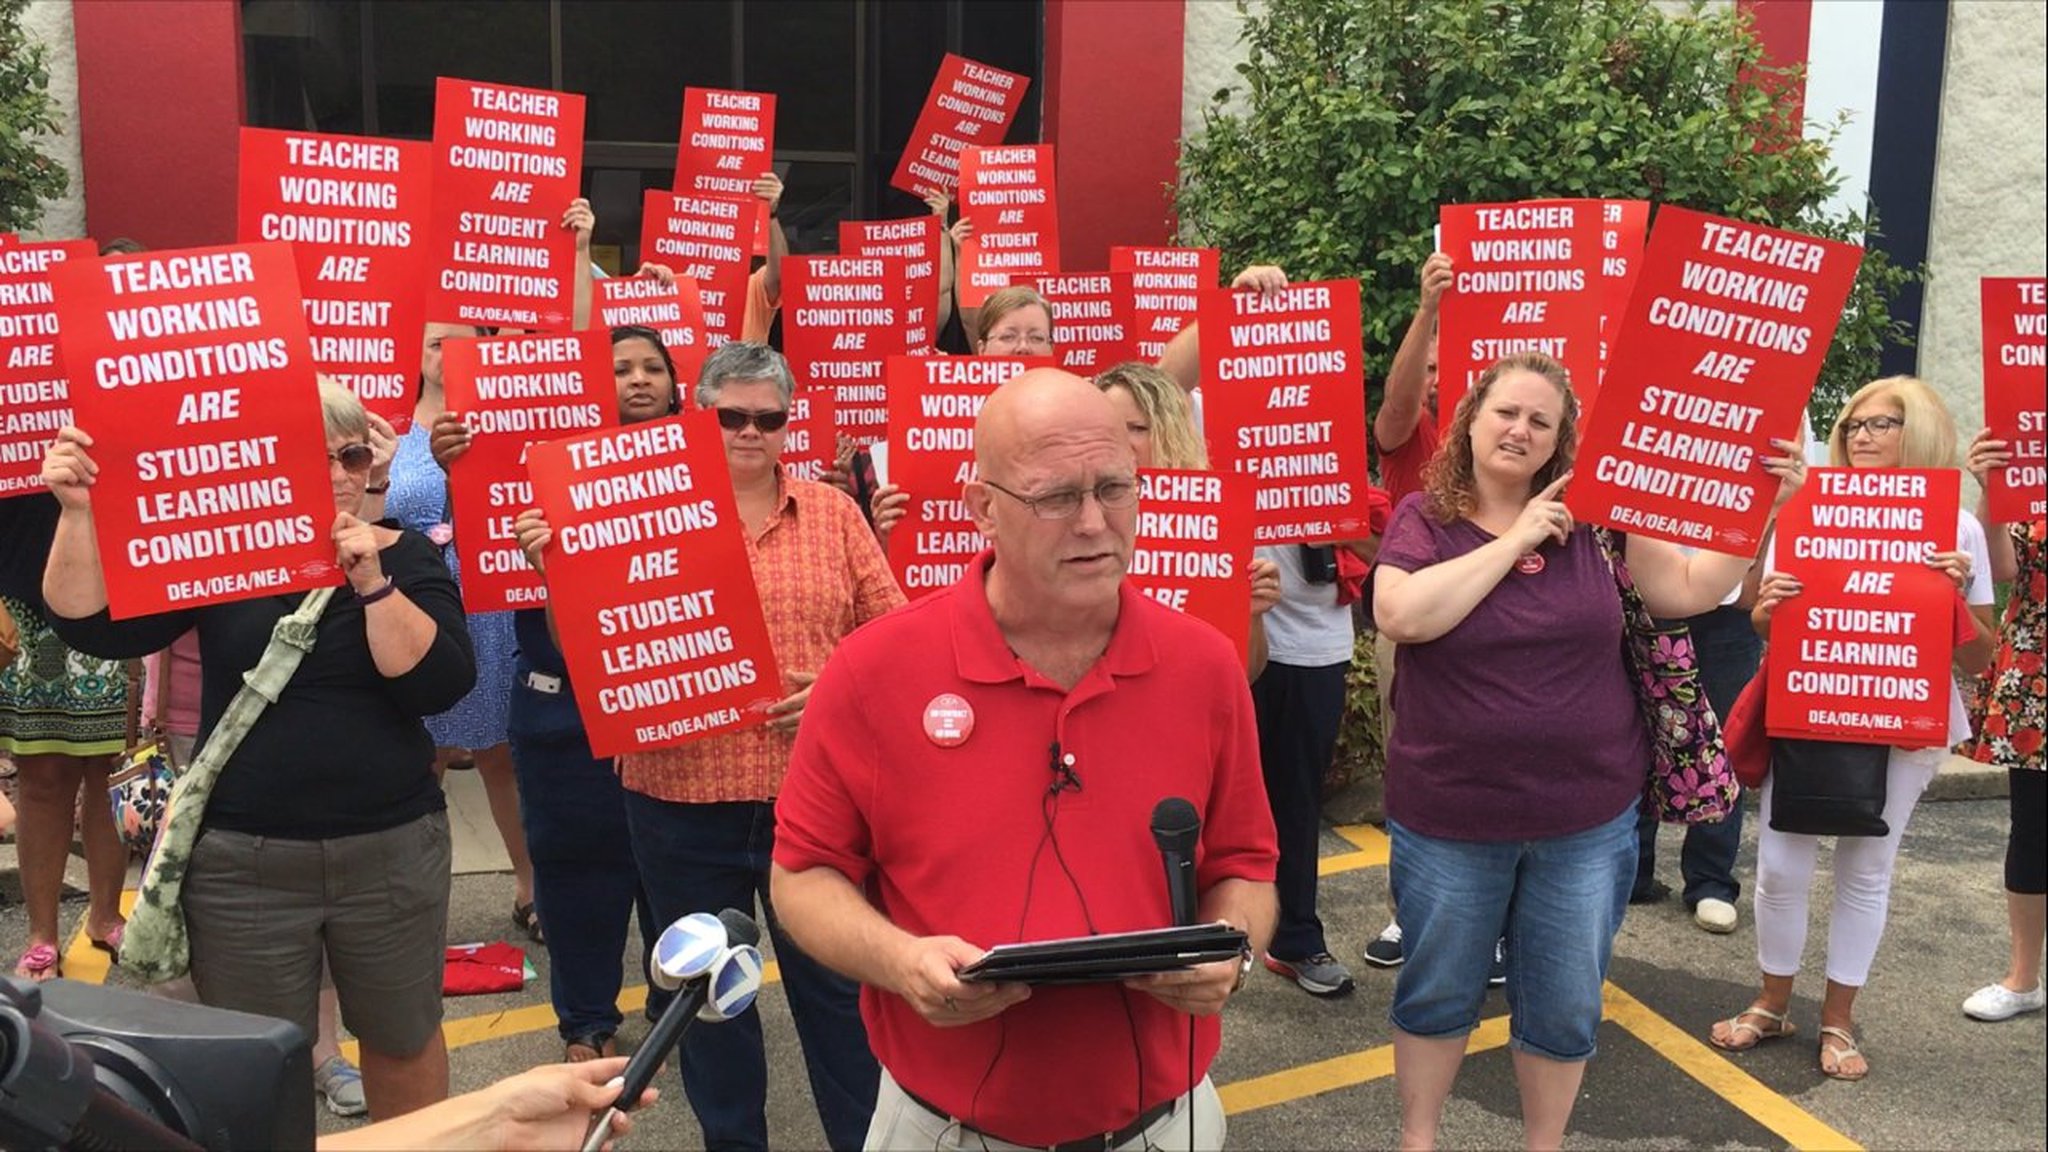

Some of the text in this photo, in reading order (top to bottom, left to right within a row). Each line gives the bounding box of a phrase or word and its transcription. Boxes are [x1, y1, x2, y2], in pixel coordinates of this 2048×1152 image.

[962, 63, 1014, 89] TEACHER
[471, 86, 559, 117] TEACHER
[706, 93, 760, 111] TEACHER
[953, 79, 1006, 106] WORKING
[937, 93, 1005, 124] CONDITIONS
[465, 116, 555, 147] WORKING
[702, 113, 758, 132] WORKING
[955, 120, 982, 136] ARE
[691, 132, 765, 151] CONDITIONS
[930, 133, 974, 152] STUD
[286, 138, 399, 172] TEACHER
[450, 146, 566, 178] CONDITIONS
[717, 155, 743, 170] ARE
[921, 148, 960, 171] LEARN
[979, 149, 1036, 165] TEACHER
[695, 175, 752, 192] STUDENT
[908, 162, 960, 187] CONDITIO
[976, 169, 1036, 186] WORKING
[280, 176, 397, 209] WORKING
[491, 180, 532, 204] ARE
[969, 189, 1046, 206] CONDITIONS
[673, 196, 738, 218] TEACHER
[998, 210, 1024, 224] ARE
[1476, 207, 1573, 231] TEACHER
[261, 213, 411, 247] CONDITIONS
[459, 212, 548, 239] STUDENT
[667, 217, 735, 240] WORKING
[864, 221, 926, 240] TEACHER
[656, 238, 742, 262] CONDITIONS
[981, 232, 1038, 248] STUDENT
[1471, 239, 1572, 262] WORKING
[1701, 222, 1825, 273] TEACHER
[454, 241, 549, 269] LEARNING
[978, 253, 1042, 267] LEARNING
[1134, 251, 1199, 267] TEACHER
[105, 252, 255, 295] TEACHER
[318, 256, 369, 282] ARE
[685, 263, 716, 281] ARE
[808, 260, 883, 277] TEACHER
[1133, 274, 1197, 289] WORKING
[1457, 270, 1584, 293] CONDITIONS
[0, 282, 54, 306] RKIN
[440, 269, 559, 298] CONDITIONS
[806, 285, 883, 302] WORKING
[1036, 276, 1111, 295] TEACHER
[1681, 260, 1809, 313] WORKING
[302, 298, 392, 327] UDENT
[602, 303, 680, 326] WORKING
[1052, 302, 1112, 320] ORKING
[1134, 294, 1197, 311] NDITION
[1502, 302, 1548, 323] ARE
[0, 312, 60, 337] DITIO
[107, 296, 260, 341] WORKING
[796, 308, 894, 326] CONDITIONS
[1151, 317, 1182, 332] ARE
[1649, 297, 1811, 355] CONDITIONS
[832, 333, 866, 350] ARE
[1052, 324, 1124, 343] NDITIONS
[1230, 319, 1331, 347] WORKING
[7, 345, 53, 368] ARE
[309, 336, 395, 363] RNING
[477, 337, 581, 366] TEACHER
[1063, 349, 1096, 366] ARE
[95, 338, 289, 390] CONDITIONS
[810, 361, 883, 378] STUDENT
[1218, 351, 1346, 380] CONDITIONS
[1692, 351, 1755, 385] ARE
[0, 379, 69, 405] UDEN
[476, 371, 583, 400] WORKING
[808, 384, 887, 402] RNING
[1267, 385, 1310, 408] ARE
[177, 388, 240, 424] ARE
[834, 408, 888, 425] DITION
[921, 394, 987, 417] WORK
[1640, 386, 1763, 434] STUDENT
[0, 408, 74, 434] ARNIN
[464, 404, 601, 435] CONDITIONS
[567, 423, 686, 470] TEACHER
[907, 427, 974, 451] CONDI
[1237, 421, 1332, 449] STUDENT
[1621, 422, 1753, 473] LEARNING
[136, 435, 278, 482] STUDENT
[569, 463, 692, 511] WORKING
[1135, 475, 1221, 502] ACHER
[1256, 482, 1351, 511] NDITIONS
[1596, 455, 1755, 513] CONDITIONS
[1818, 473, 1926, 498] TEACHER
[136, 476, 292, 524] LEARNING
[560, 499, 718, 554] CONDITIONS
[1135, 512, 1218, 540] RKING
[1254, 521, 1332, 540] EA/OEA/NEA
[1610, 504, 1714, 541] DEA/OEA/NEA
[1812, 505, 1923, 531] WORKING
[127, 515, 314, 568] CONDITIONS
[917, 531, 992, 554] LEARN
[1795, 536, 1937, 565] CONDITIONS
[627, 548, 678, 583] ARE
[1126, 549, 1233, 578] DITIONS
[167, 566, 290, 601] DEA/OEA/NEA
[1843, 571, 1894, 594] ARE
[598, 589, 714, 636] STUDENT
[1808, 607, 1915, 634] STUDENT
[602, 626, 733, 675] LEARNING
[1801, 639, 1918, 668] LEARNING
[599, 659, 756, 714] CONDITIONS
[1787, 671, 1929, 701] CONDITIONS
[636, 707, 740, 744] DEA/OEA/NEA
[1809, 710, 1902, 729] DEA/OEA/NEA
